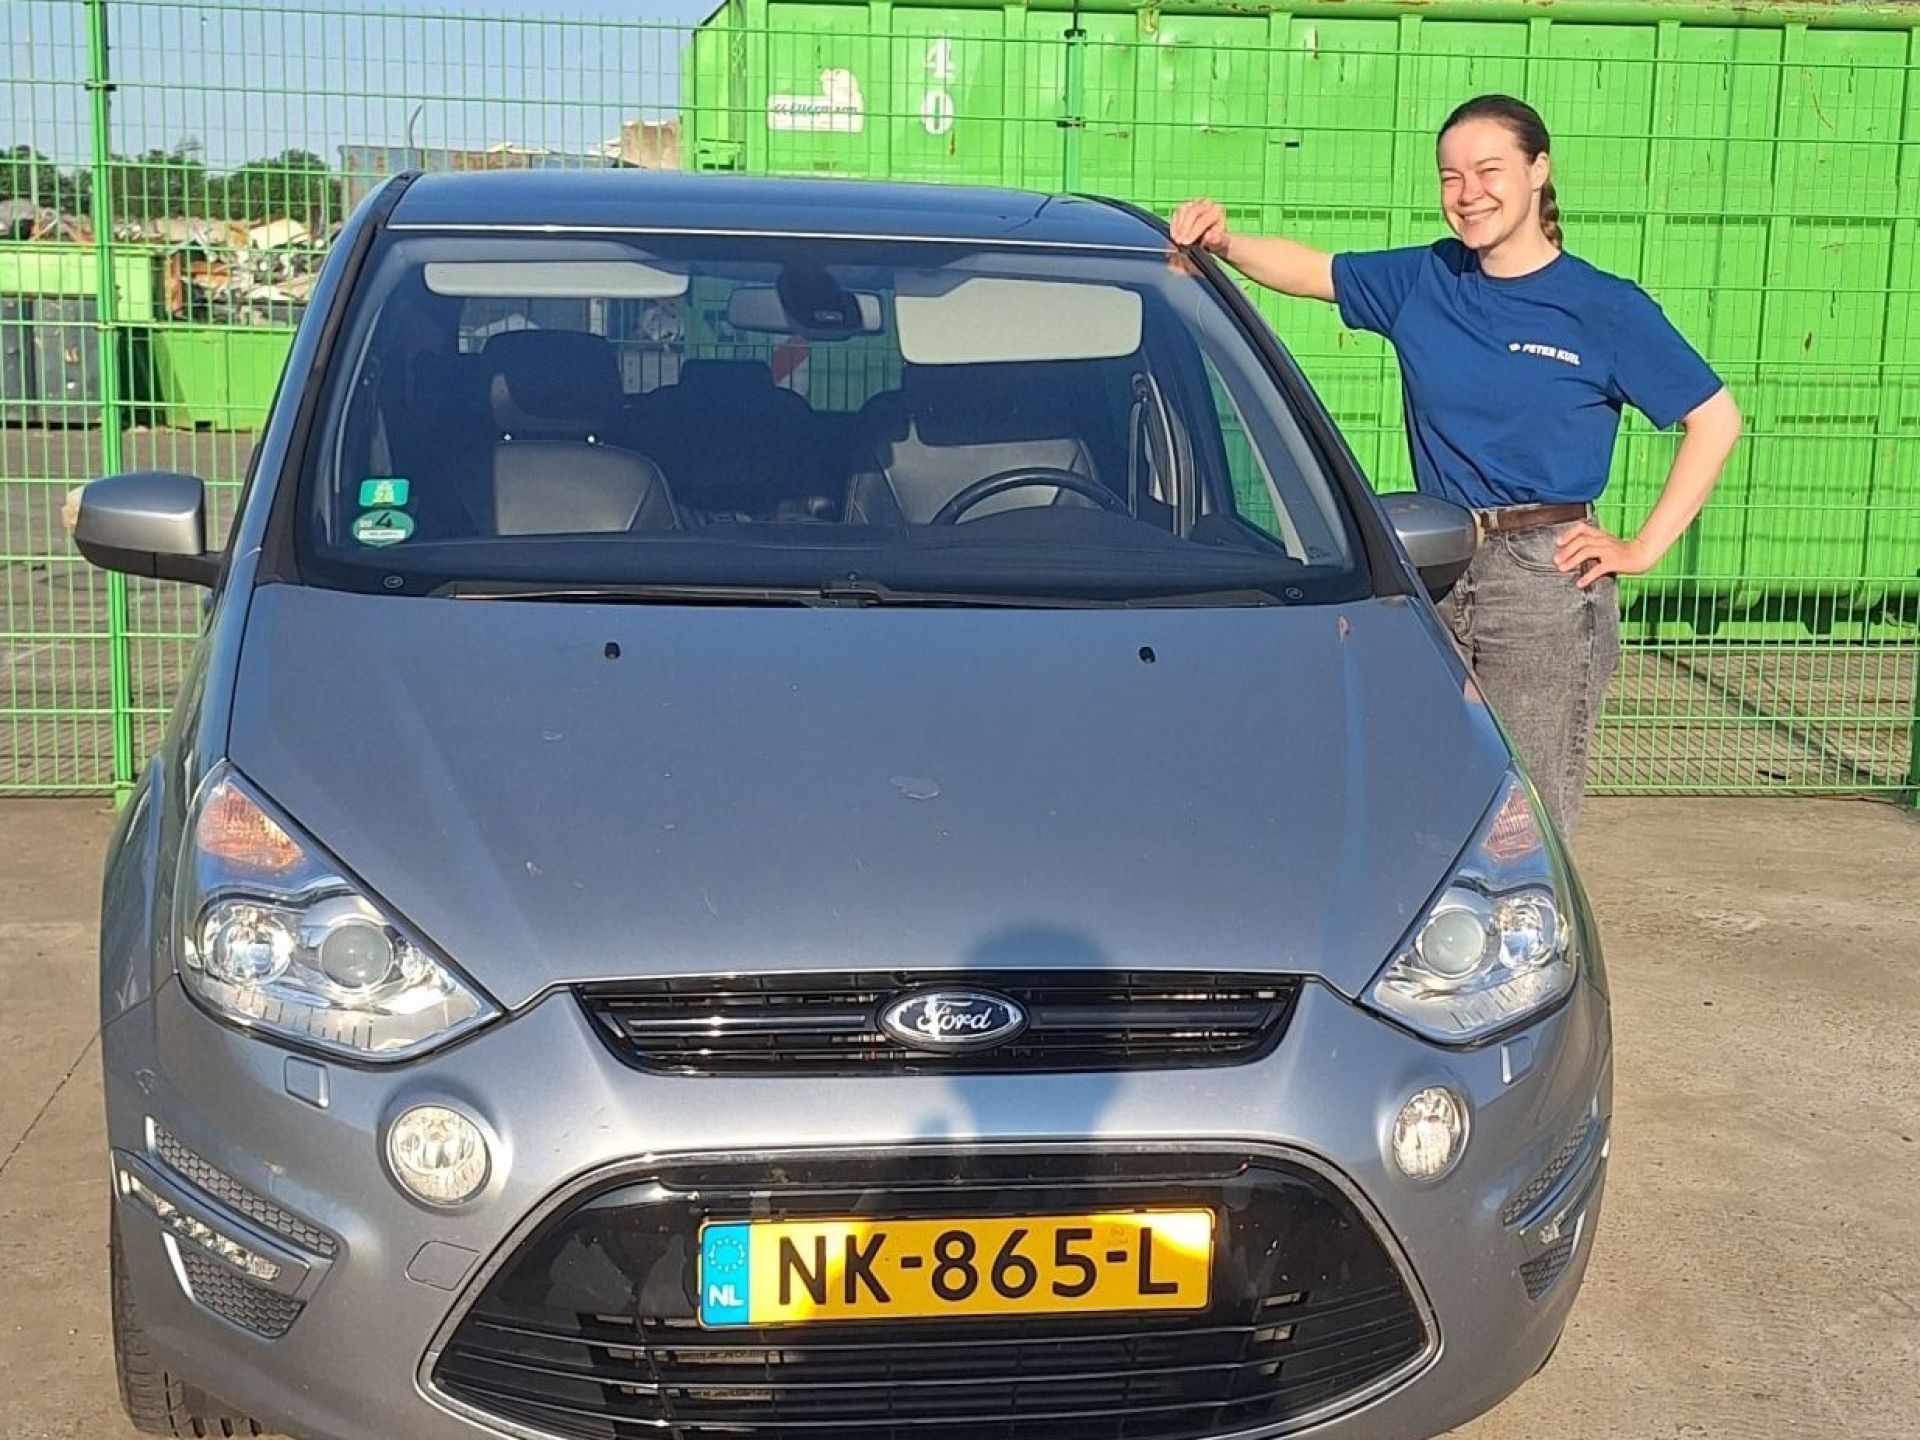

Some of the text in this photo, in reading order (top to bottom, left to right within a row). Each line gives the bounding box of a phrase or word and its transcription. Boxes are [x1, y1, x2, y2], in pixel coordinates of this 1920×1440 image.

[1522, 343, 1556, 357] PETER
[916, 999, 993, 1032] Ford
[707, 1227, 1179, 1308] NL NK-865-L
